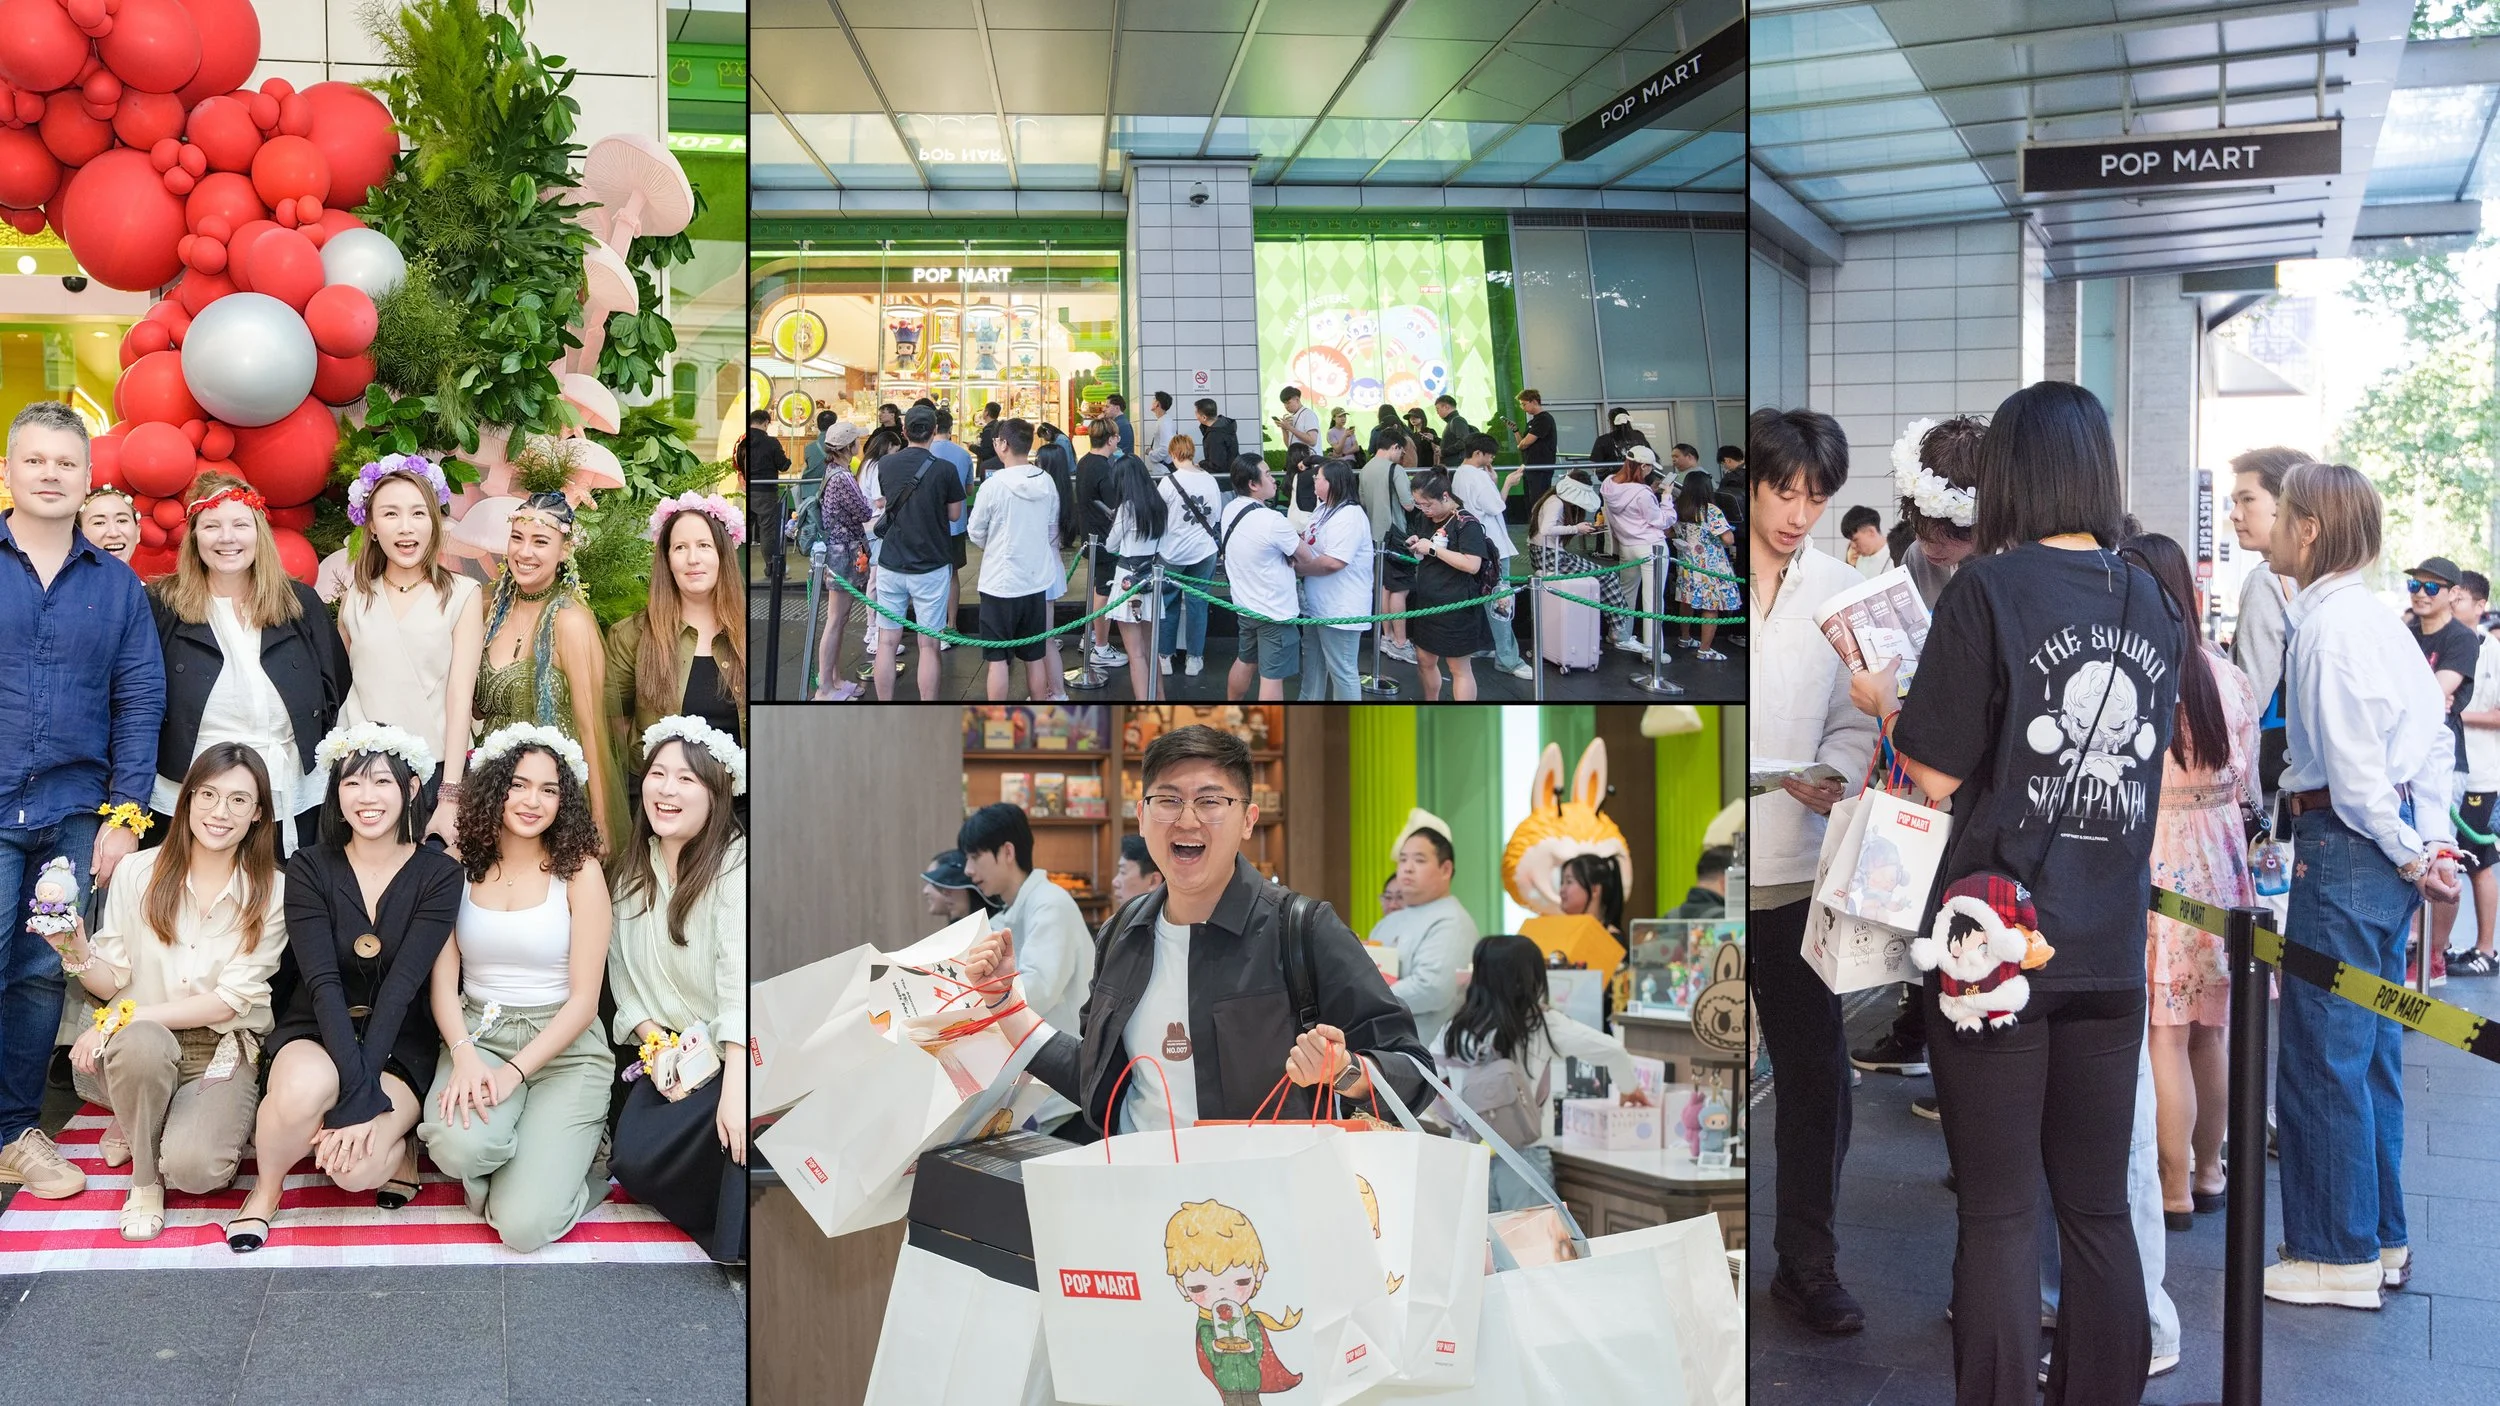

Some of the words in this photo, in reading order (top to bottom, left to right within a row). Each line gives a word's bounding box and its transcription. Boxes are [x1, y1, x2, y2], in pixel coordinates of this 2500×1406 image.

[1600, 96, 1635, 129] POP
[1642, 54, 1702, 104] MART
[2101, 152, 2161, 177] POP
[2173, 145, 2261, 173] MART
[913, 267, 952, 283] POP
[958, 267, 1012, 283] MART
[2199, 491, 2212, 528] JACK'S
[2199, 528, 2212, 558] CAFE
[2029, 624, 2082, 675] THE
[2091, 623, 2167, 683] SOUND
[2025, 775, 2147, 823] SKULLPANDA
[1898, 813, 1911, 826] POP
[1910, 817, 1929, 831] MART
[2180, 900, 2190, 919] POP
[2190, 903, 2205, 925] MART
[2373, 985, 2399, 1011] POP
[2394, 993, 2431, 1024] MART
[806, 1158, 817, 1170] POP
[813, 1166, 827, 1182] MART
[1063, 1273, 1092, 1294] POP
[1094, 1274, 1135, 1297] MART
